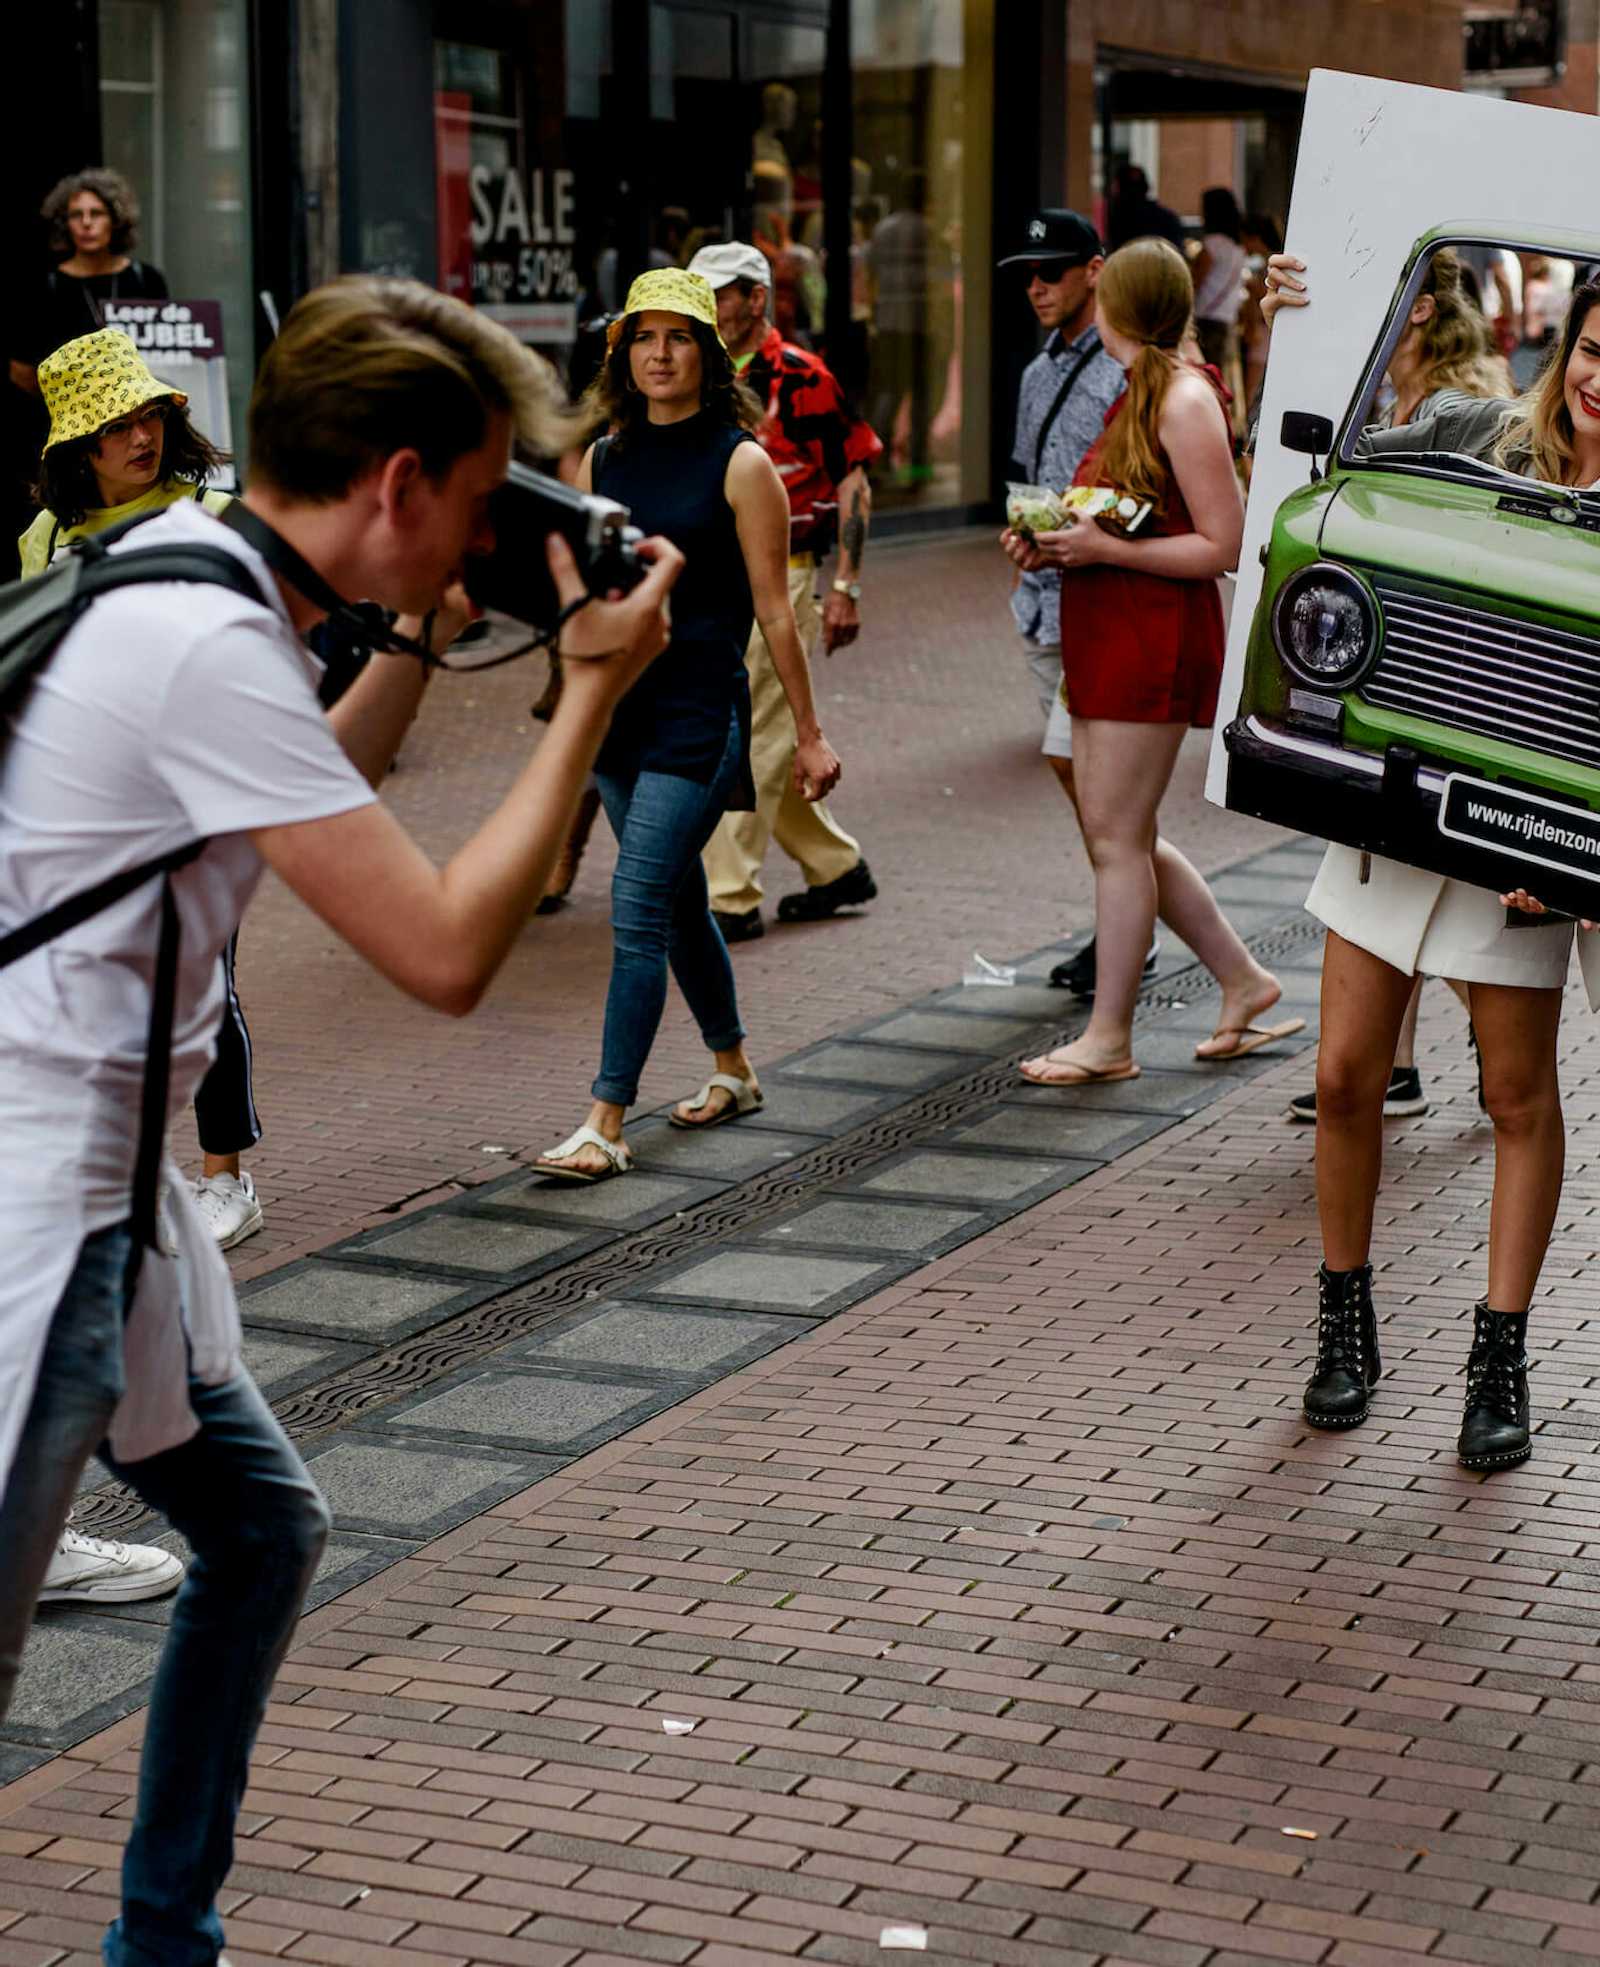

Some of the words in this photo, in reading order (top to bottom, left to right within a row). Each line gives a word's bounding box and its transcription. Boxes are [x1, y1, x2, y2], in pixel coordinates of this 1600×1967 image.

[470, 165, 576, 244] SALE
[518, 248, 578, 297] 50%
[104, 303, 157, 322] Leer
[161, 303, 191, 322] de
[107, 323, 214, 348] IJBEL
